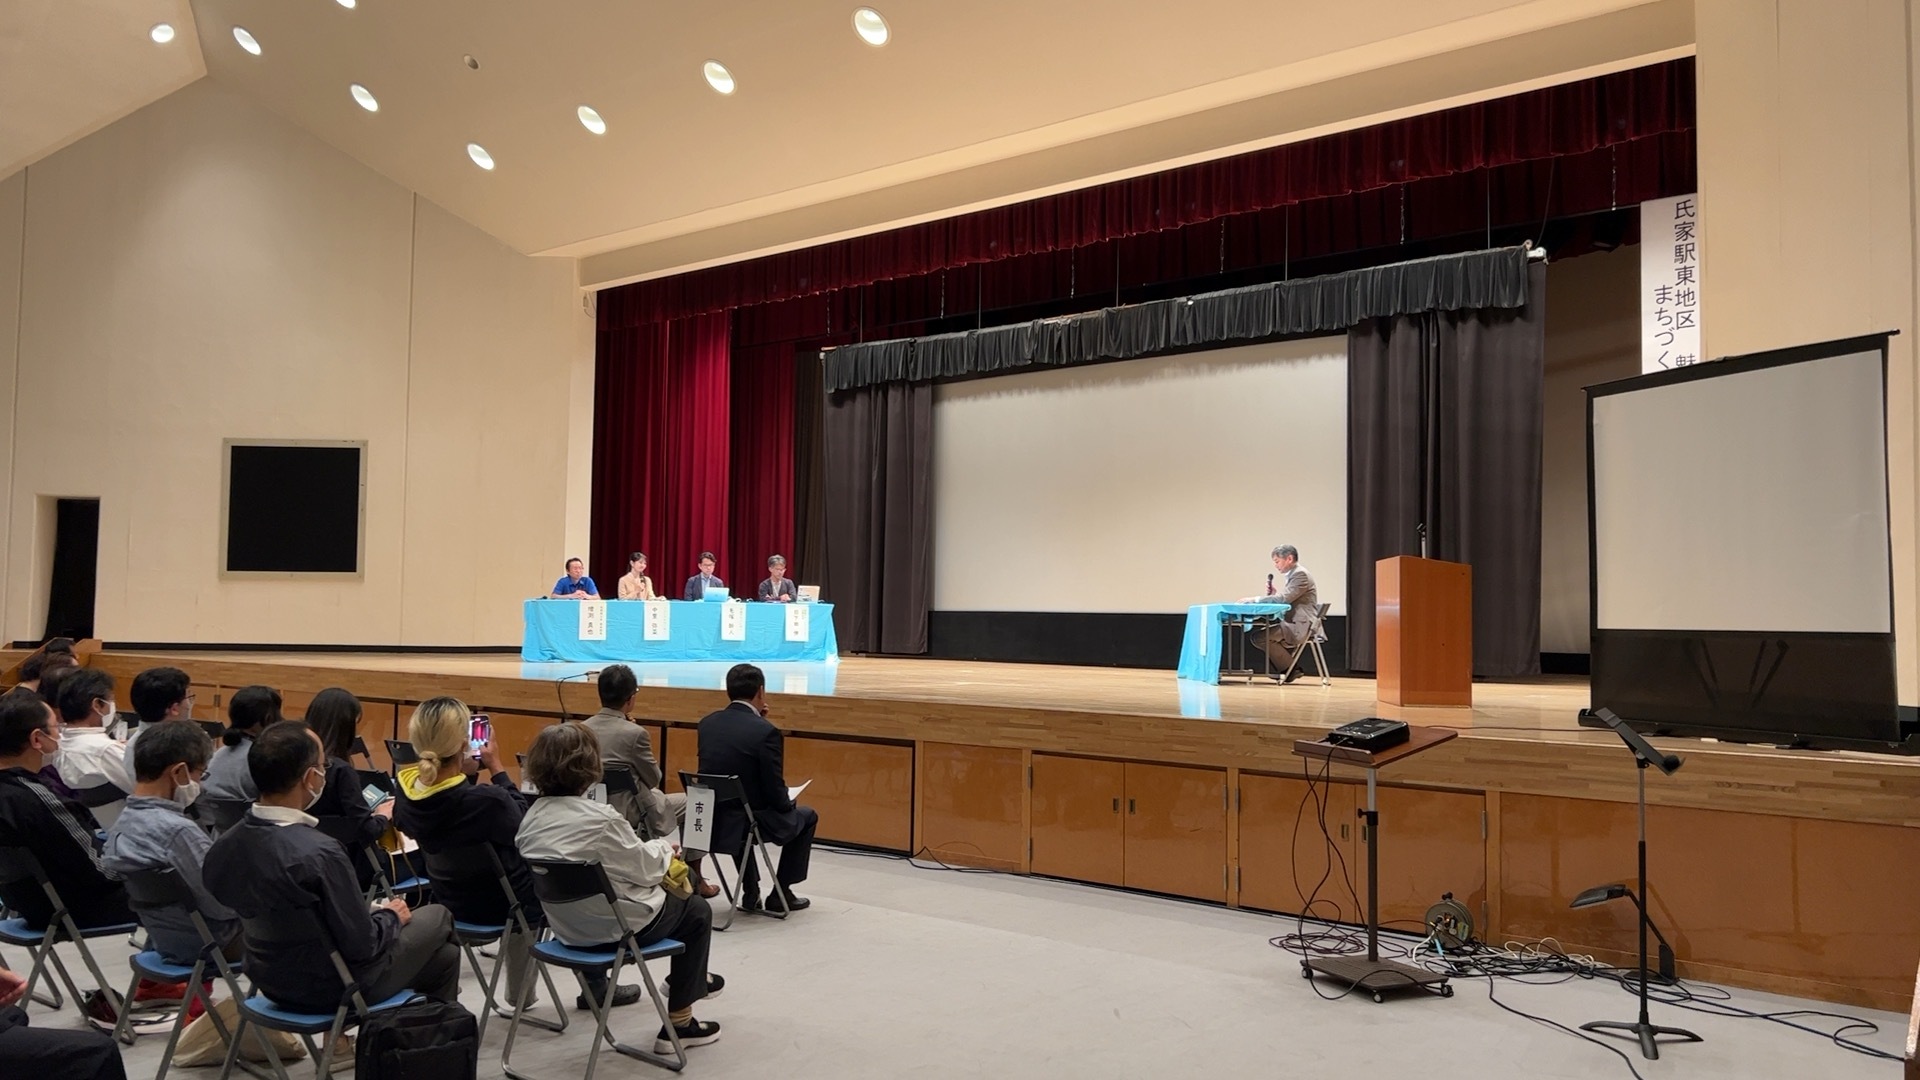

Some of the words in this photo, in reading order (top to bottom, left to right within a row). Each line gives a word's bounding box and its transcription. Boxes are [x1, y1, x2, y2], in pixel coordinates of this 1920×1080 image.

[1674, 199, 1696, 330] 氏家駅東地区
[1654, 284, 1675, 369] まちづく
[694, 801, 704, 832] 市長
